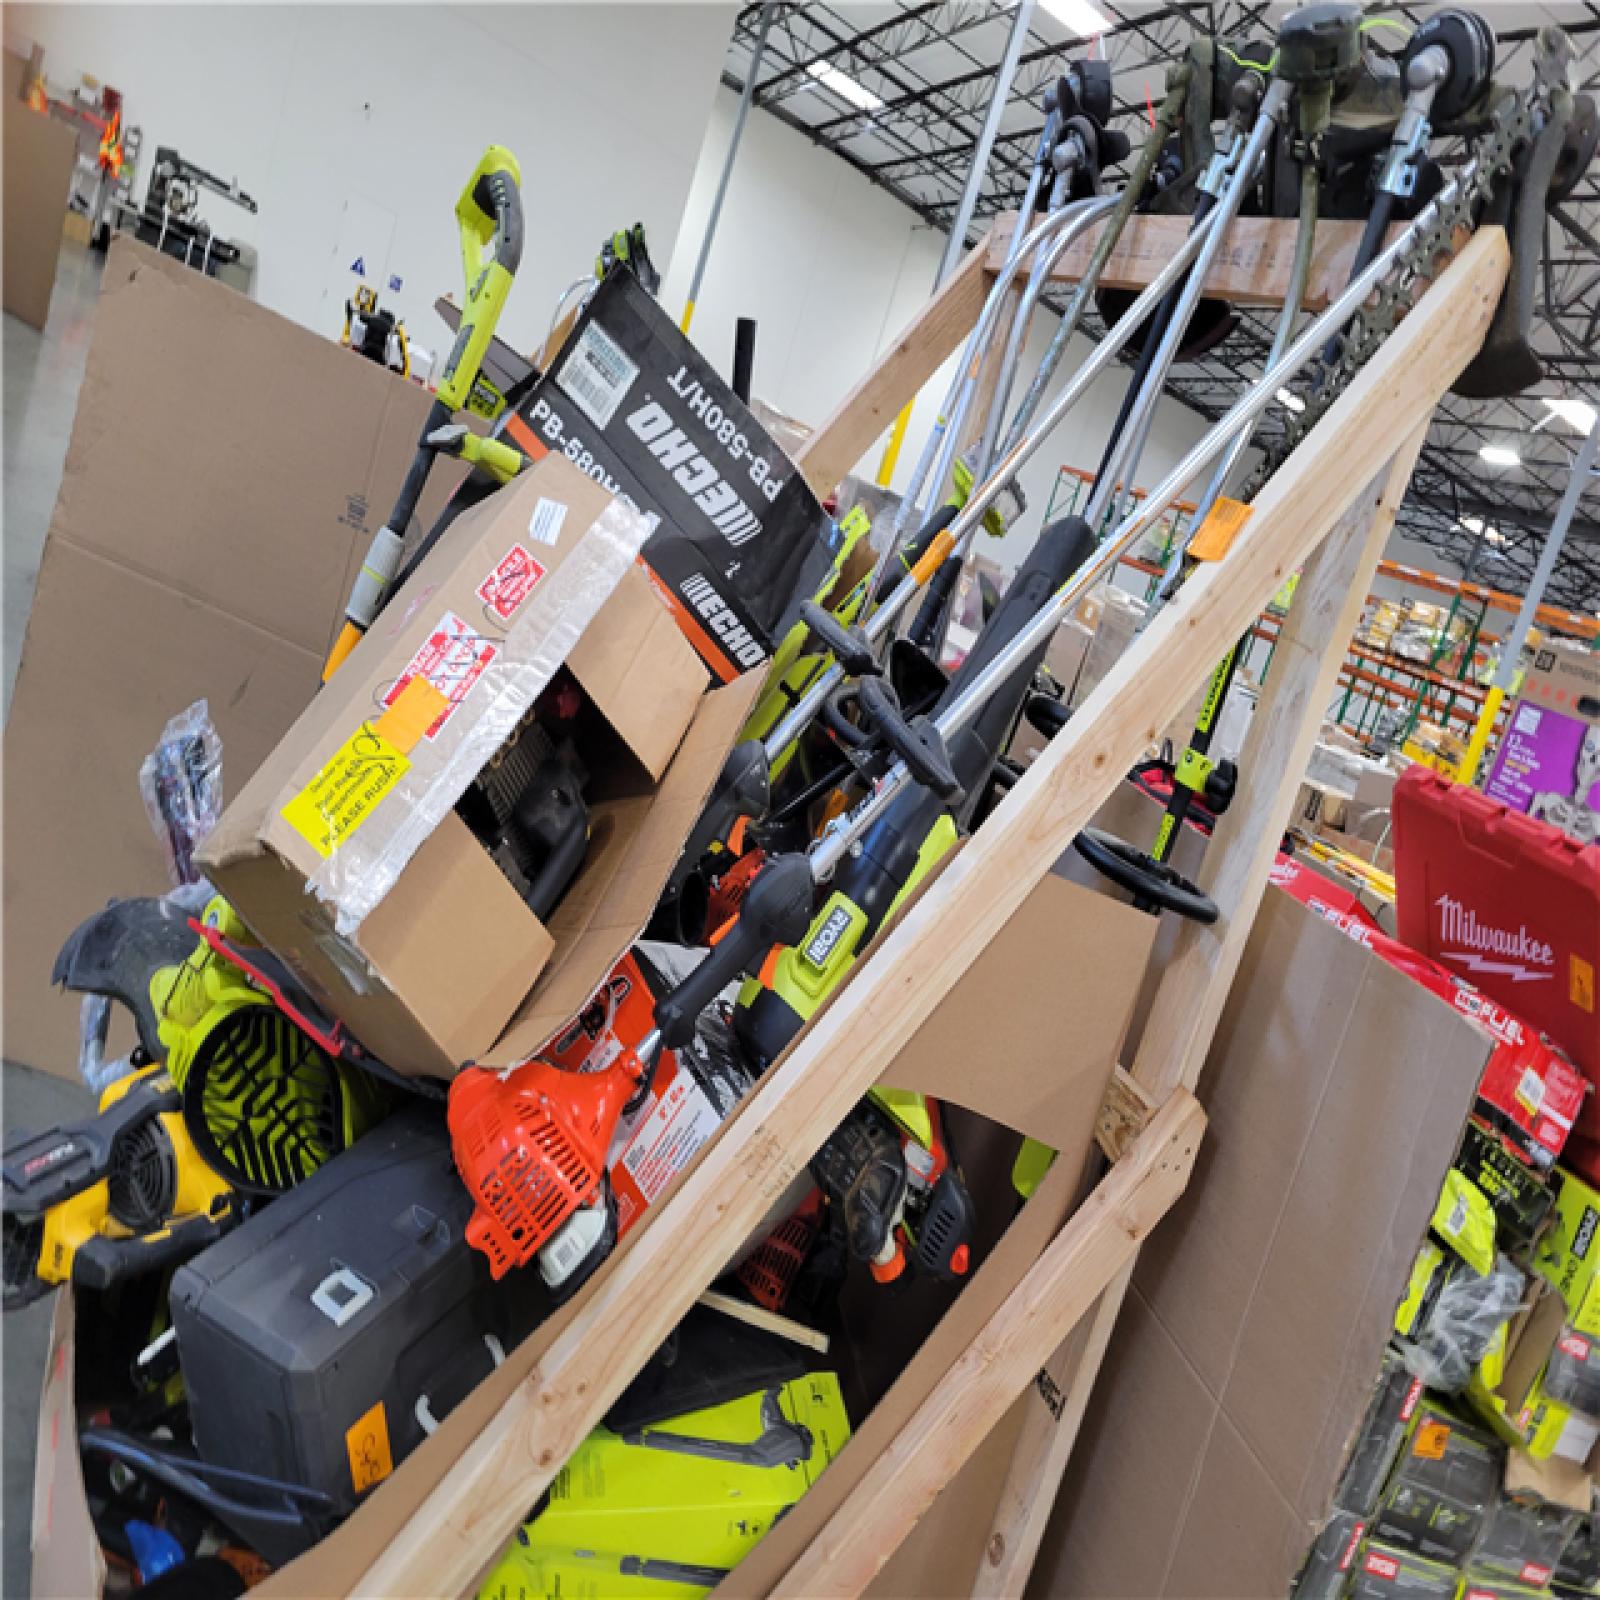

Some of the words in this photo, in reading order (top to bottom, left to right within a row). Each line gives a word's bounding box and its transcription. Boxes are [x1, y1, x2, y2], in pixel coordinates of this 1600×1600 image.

[625, 401, 762, 546] ECHO
[666, 365, 784, 502] PB-580H/T
[681, 573, 766, 666] ECHO
[809, 909, 849, 961] RYOBI
[1435, 893, 1554, 965] Milwaukee
